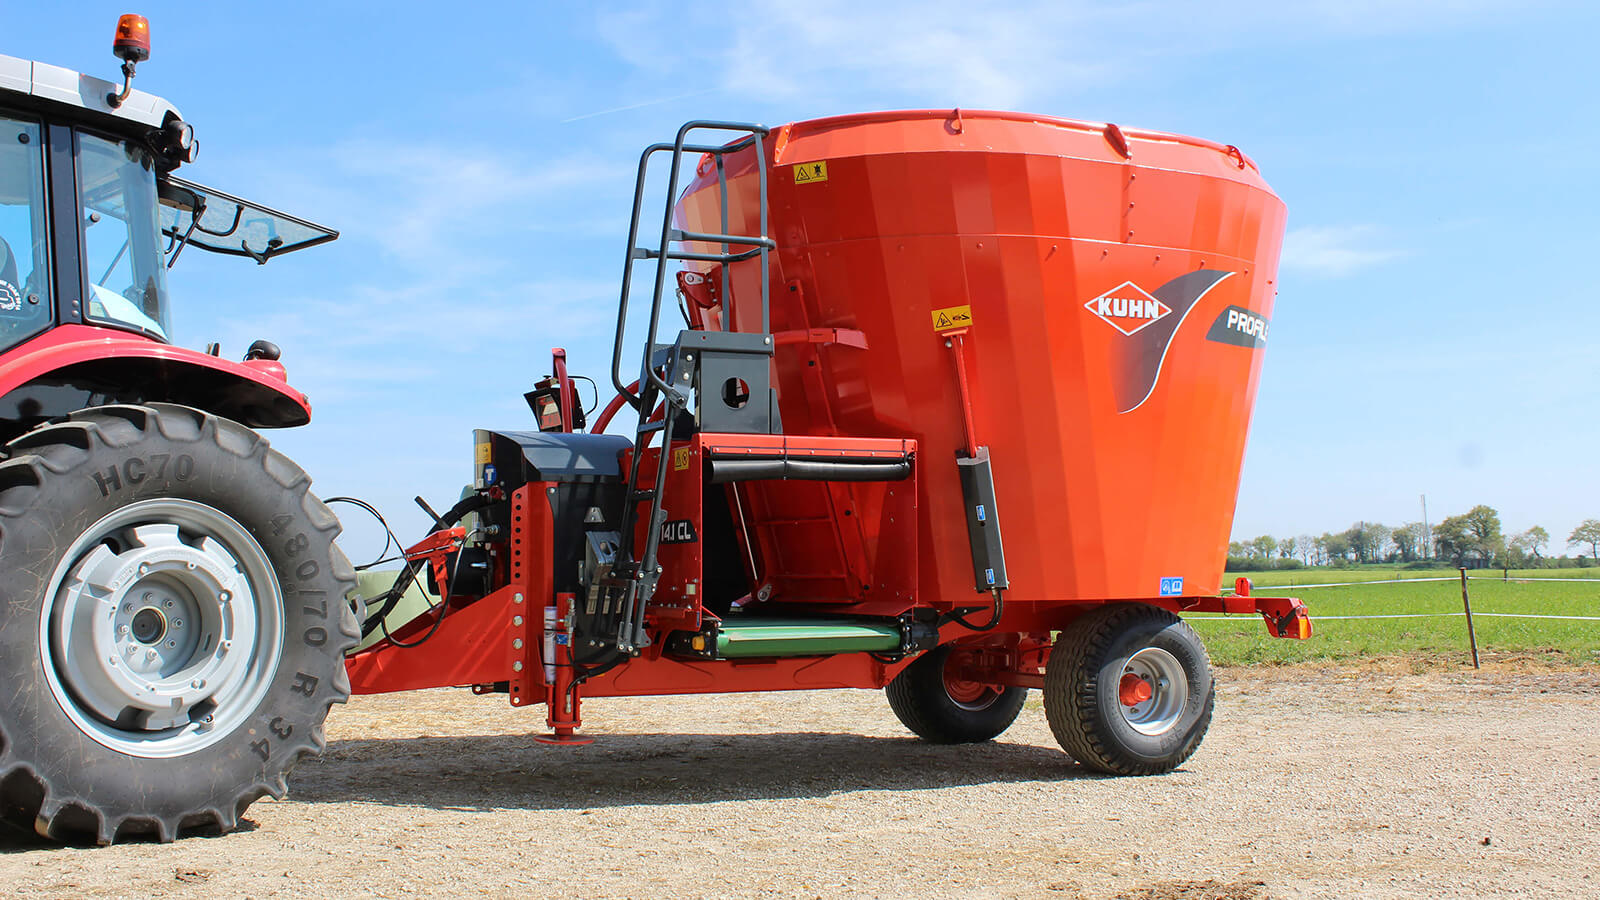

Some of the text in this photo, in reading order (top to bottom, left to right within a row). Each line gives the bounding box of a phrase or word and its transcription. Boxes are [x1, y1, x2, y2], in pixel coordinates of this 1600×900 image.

[1097, 297, 1160, 320] KUHN
[91, 452, 195, 497] HC70
[677, 520, 692, 541] CL
[250, 511, 330, 763] 480/70 R 34
